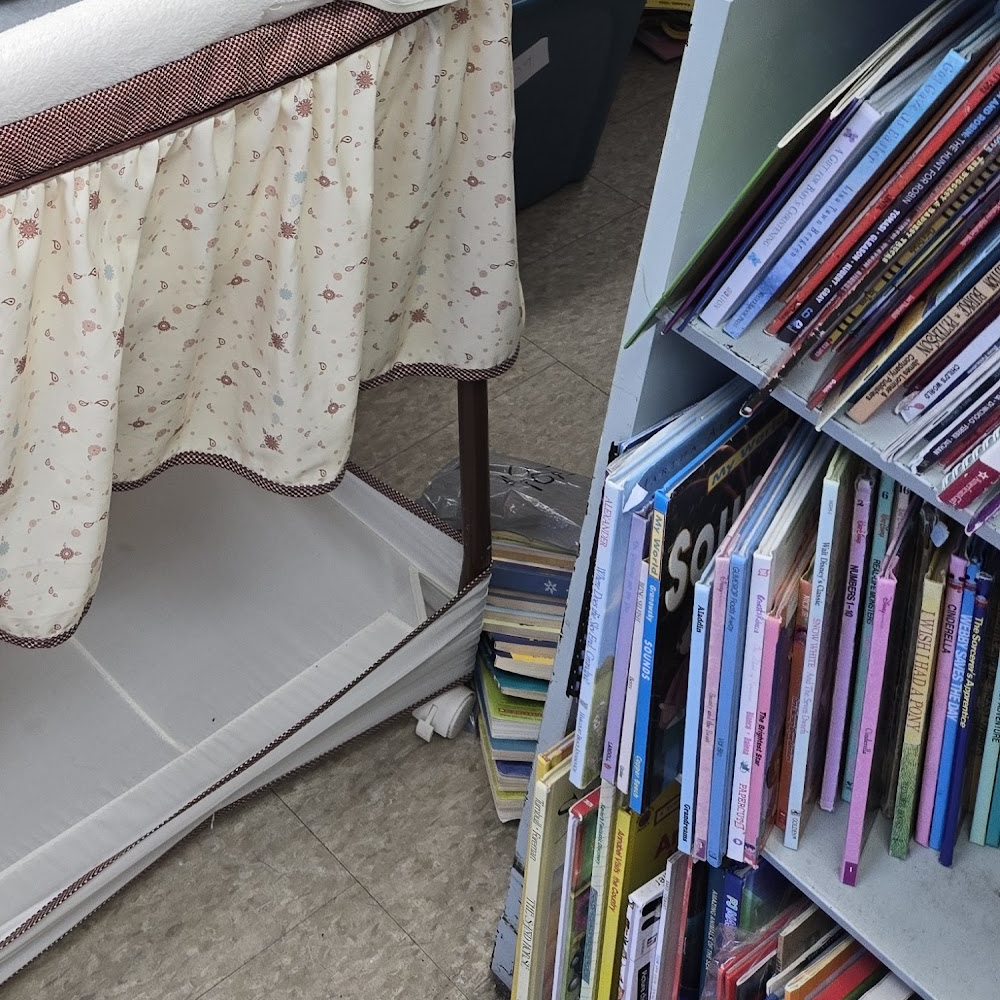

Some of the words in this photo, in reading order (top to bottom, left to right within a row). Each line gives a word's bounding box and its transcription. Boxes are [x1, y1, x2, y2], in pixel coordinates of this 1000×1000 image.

[982, 98, 999, 116] AND
[864, 126, 899, 165] Easter
[948, 136, 965, 153] THE
[932, 149, 954, 171] HUNT
[968, 154, 985, 171] THE
[920, 167, 937, 185] FOR
[938, 170, 969, 202] BIGGEST
[832, 184, 853, 207] Lisa
[901, 181, 924, 205] ROBIN
[876, 207, 901, 233] TOMASI
[904, 207, 934, 238] BADDEST
[850, 232, 878, 262] GLEASON
[829, 261, 852, 285] KUBERT
[813, 286, 831, 303] GRAY
[957, 286, 987, 317] BURKE
[916, 315, 959, 357] PETERSON
[901, 358, 920, 377] James
[939, 362, 960, 384] CHILD'S
[865, 375, 892, 402] Publishers
[923, 380, 942, 400] WORLD
[882, 491, 888, 500] 6
[599, 496, 613, 547] ALEXANDER
[653, 514, 663, 535] My
[650, 539, 661, 575] World
[820, 542, 829, 556] Walt
[593, 566, 605, 592] Where
[729, 566, 740, 596] GUMDROP
[815, 556, 827, 583] Disney's
[814, 584, 824, 606] Classic
[845, 564, 858, 601] NUMBERS
[645, 584, 656, 622] Granowsky
[865, 591, 876, 624] MONSTERS
[695, 605, 704, 632] Aladdin
[810, 618, 820, 641] SNOW
[941, 603, 955, 654] CINDERELLA
[972, 618, 982, 633] The
[916, 617, 934, 650] WISH
[957, 613, 971, 650] WEBBY
[640, 639, 653, 680] SOUNDS
[807, 642, 817, 667] WHITE
[953, 650, 967, 682] SAVES
[965, 634, 980, 679] Sorcerer's
[912, 657, 929, 686] HAD
[910, 688, 924, 698] A
[950, 682, 963, 701] THE
[958, 679, 973, 728] Apprentice
[758, 711, 766, 722] The
[906, 698, 924, 733] PONY
[947, 702, 960, 722] DAY
[754, 724, 765, 752] Brightest
[604, 741, 613, 761] LANDOLL
[754, 753, 762, 765] Star
[681, 803, 690, 842] Grandreams
[527, 829, 542, 861] Foreman
[612, 829, 627, 856] Annabel
[613, 858, 623, 872] Visits
[611, 876, 621, 886] the
[524, 897, 536, 916] THE
[608, 887, 620, 912] Country
[709, 889, 718, 915] AMAZING
[707, 915, 715, 939] ANIMALS
[707, 940, 712, 948] OF
